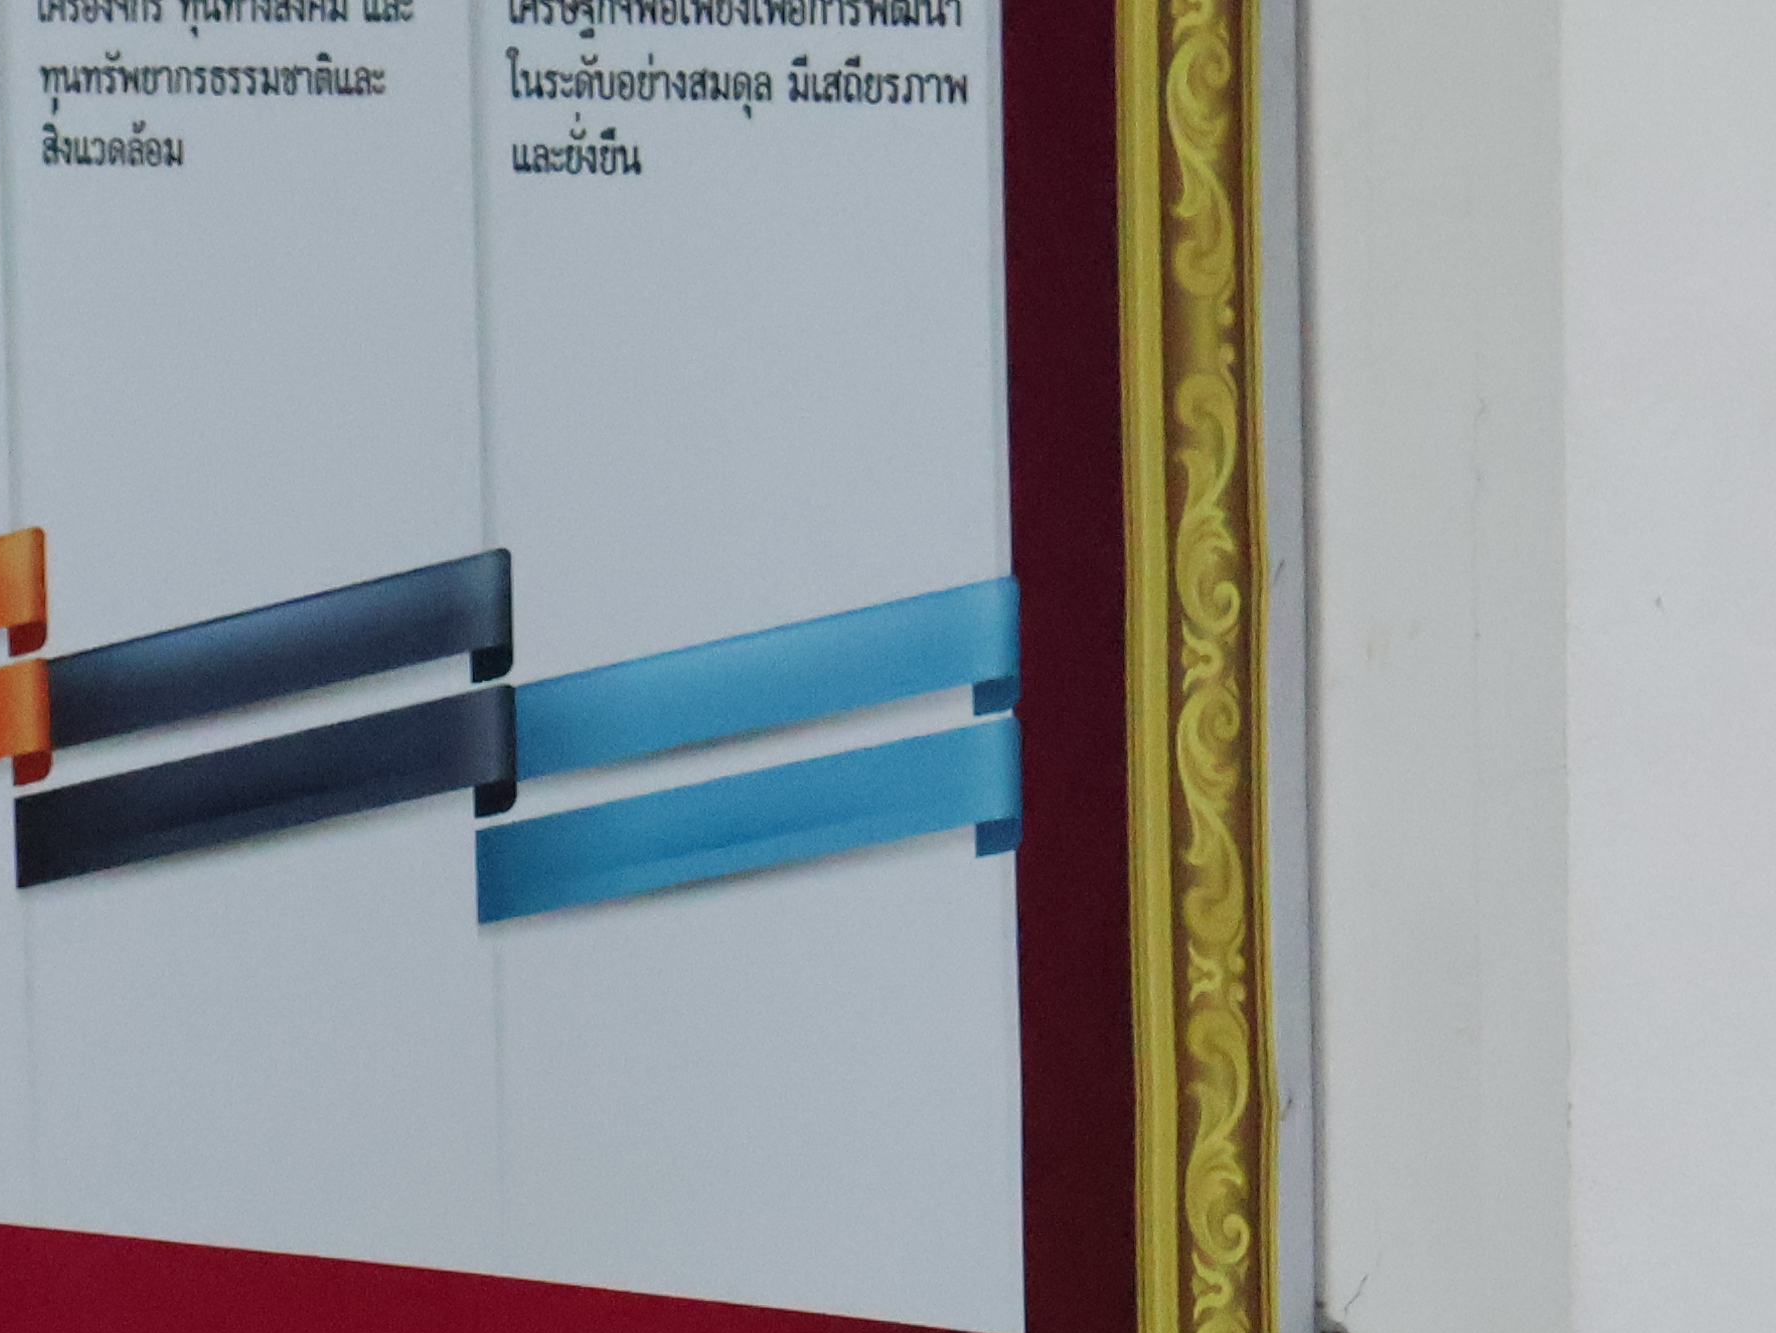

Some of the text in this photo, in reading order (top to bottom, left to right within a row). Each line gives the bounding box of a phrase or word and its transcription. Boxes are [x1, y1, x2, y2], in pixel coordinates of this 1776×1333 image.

[39, 51, 386, 112] ทุนทรัพยากรธรรมชาติและ
[504, 45, 969, 119] ในระดับอย่างสมดุล มีเสถียรภาพ
[511, 111, 642, 177] และยั่งยืน
